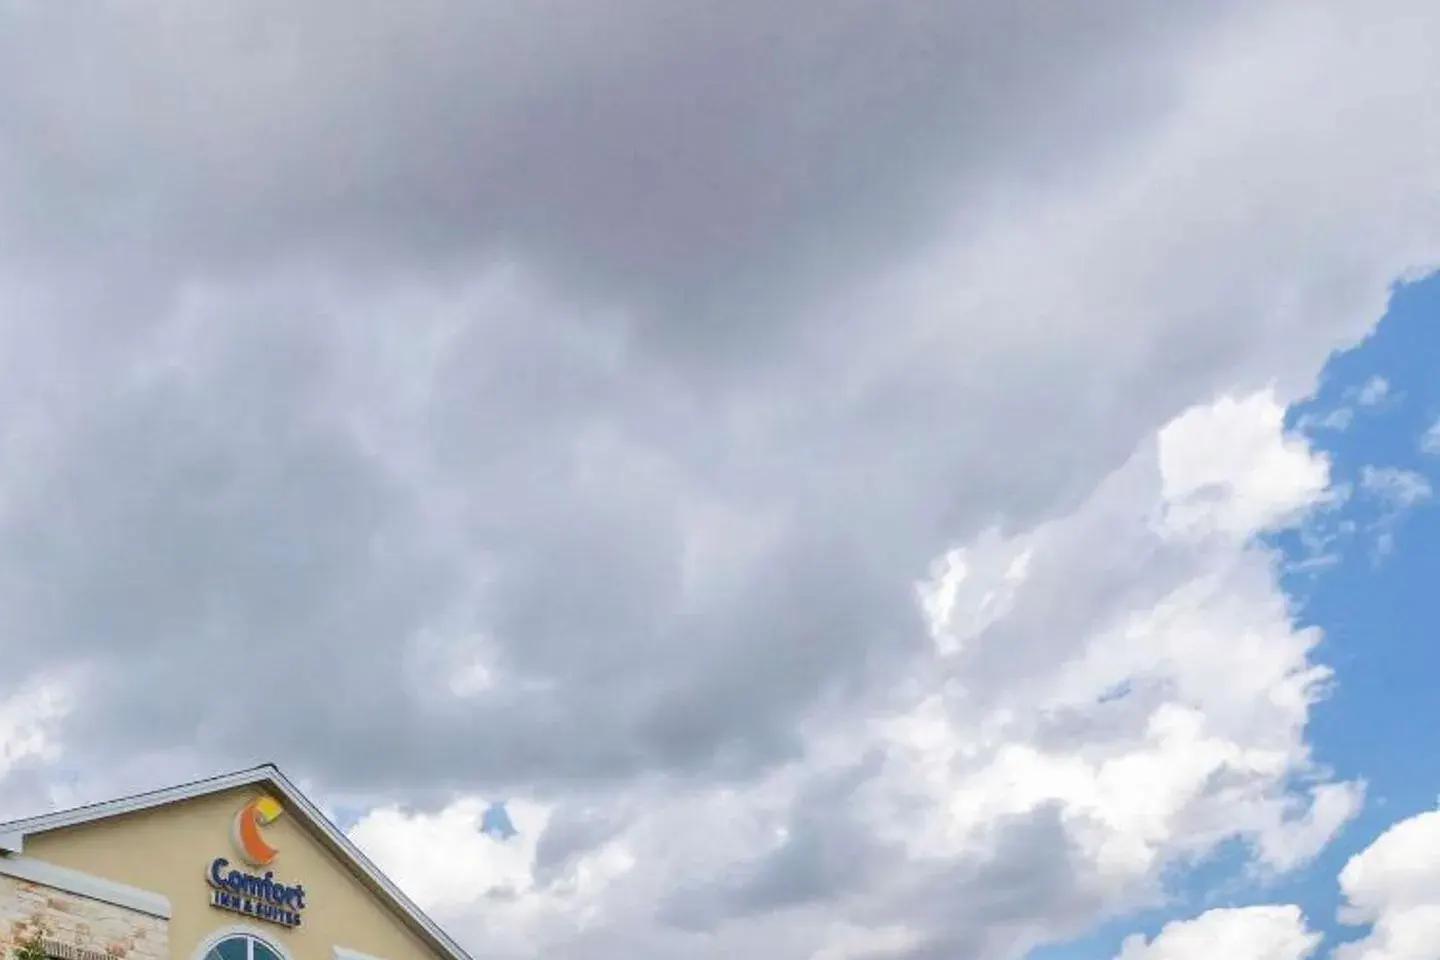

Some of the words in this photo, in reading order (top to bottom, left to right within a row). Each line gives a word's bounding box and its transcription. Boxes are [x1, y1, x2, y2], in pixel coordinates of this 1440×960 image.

[210, 857, 305, 909] Comfort
[215, 891, 241, 908] INN
[243, 898, 253, 913] &
[256, 901, 301, 926] SUITES
